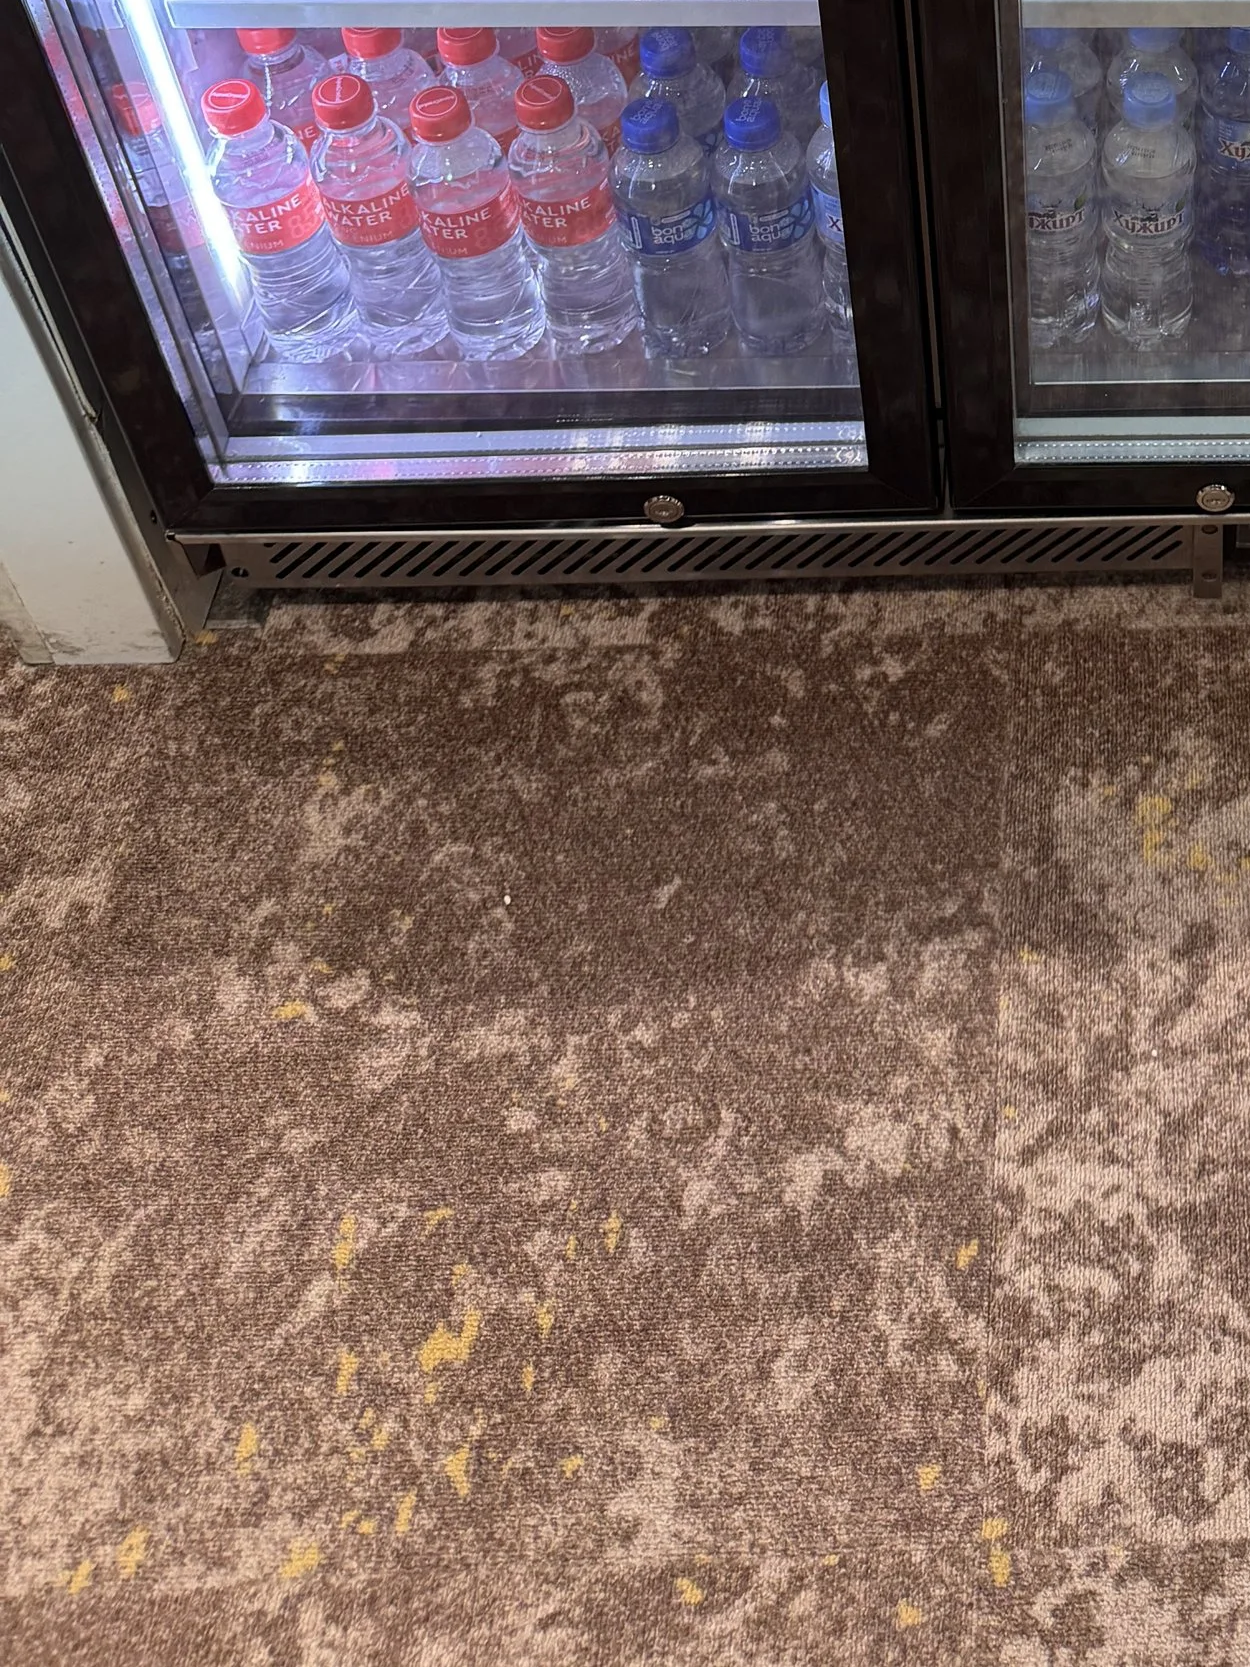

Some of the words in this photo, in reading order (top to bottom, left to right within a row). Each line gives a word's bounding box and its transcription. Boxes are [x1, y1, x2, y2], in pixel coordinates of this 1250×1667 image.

[232, 194, 302, 222] KALINE
[522, 196, 592, 217] KALINE
[421, 207, 492, 229] KALINE
[523, 211, 567, 228] ATER
[1113, 209, 1184, 234] Хужирт
[233, 220, 282, 235] ATER
[422, 222, 468, 240] ATER
[651, 225, 683, 236] bon
[749, 224, 780, 235] bon
